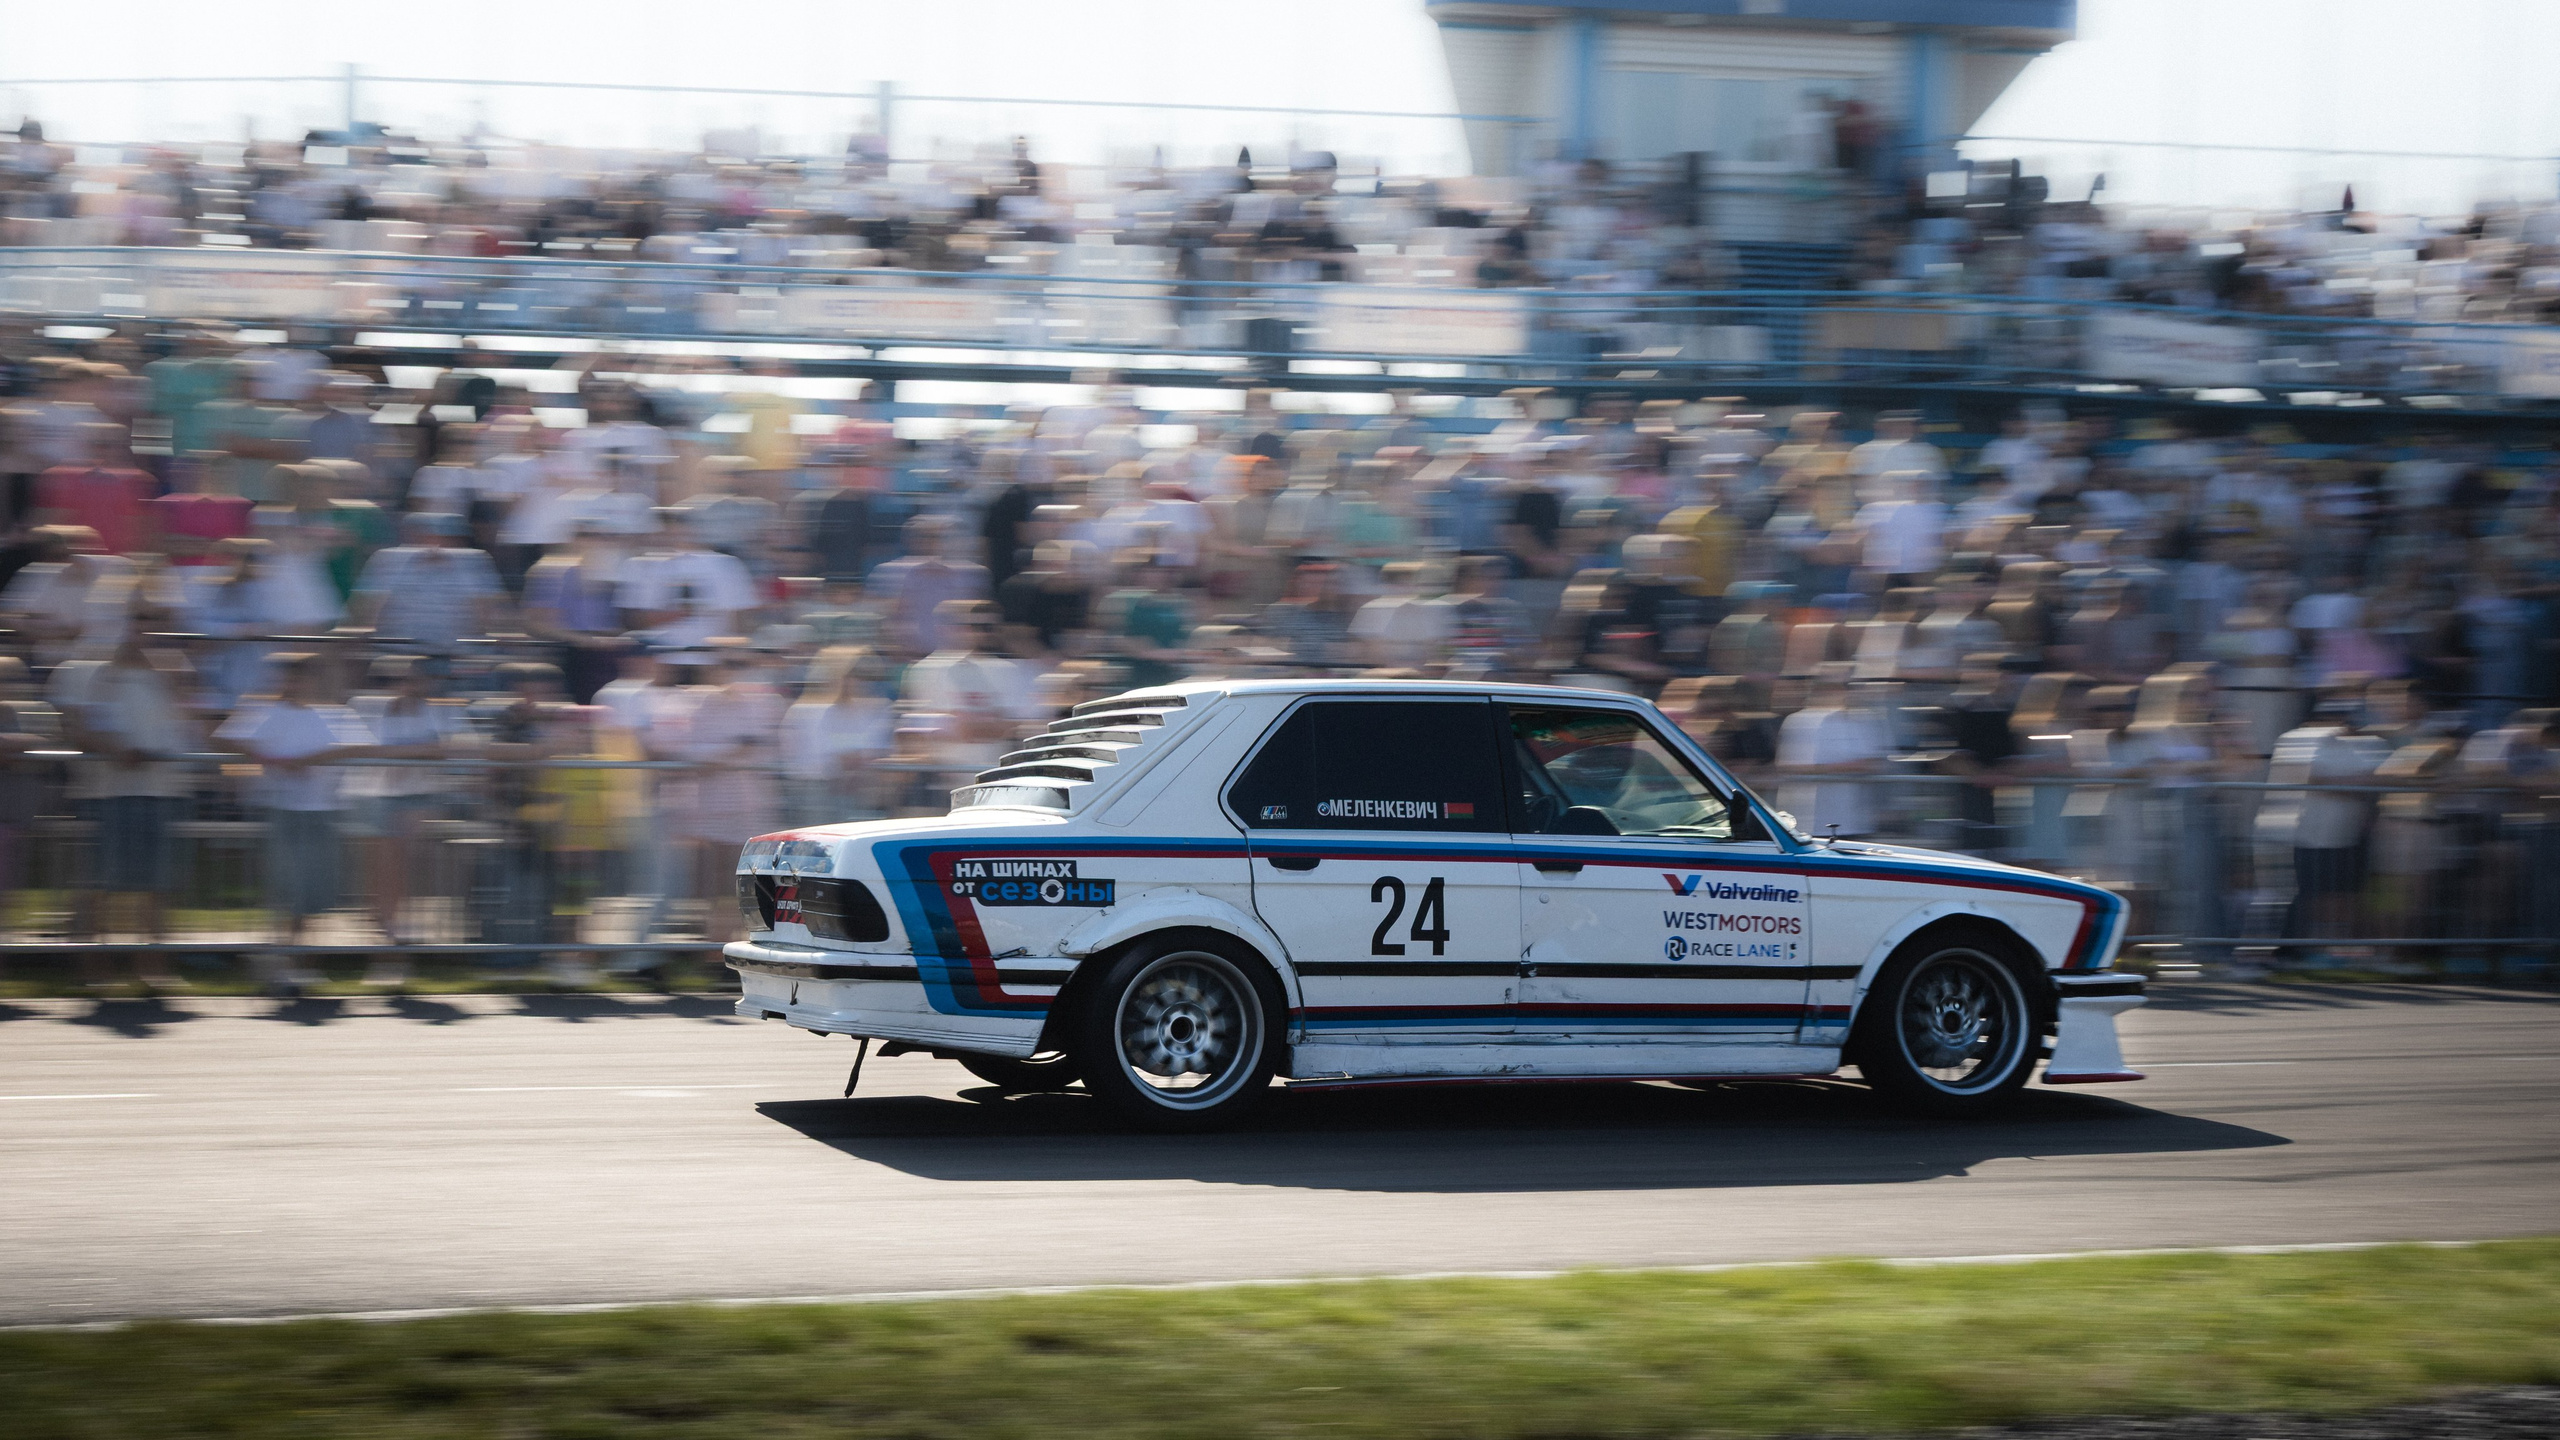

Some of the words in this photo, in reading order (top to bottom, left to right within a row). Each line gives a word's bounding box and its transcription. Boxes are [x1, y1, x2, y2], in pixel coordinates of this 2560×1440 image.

[1329, 799, 1437, 819] МЕЛЕНКЕВИЧ
[956, 863, 987, 878] НА
[993, 863, 1073, 878] ШИНАХ
[1705, 882, 1800, 903] Valvoline
[1371, 876, 1450, 956] 24
[1663, 911, 1802, 934] WESTMOTORS
[1691, 943, 1733, 956] RACE
[1737, 944, 1781, 957] LANE
